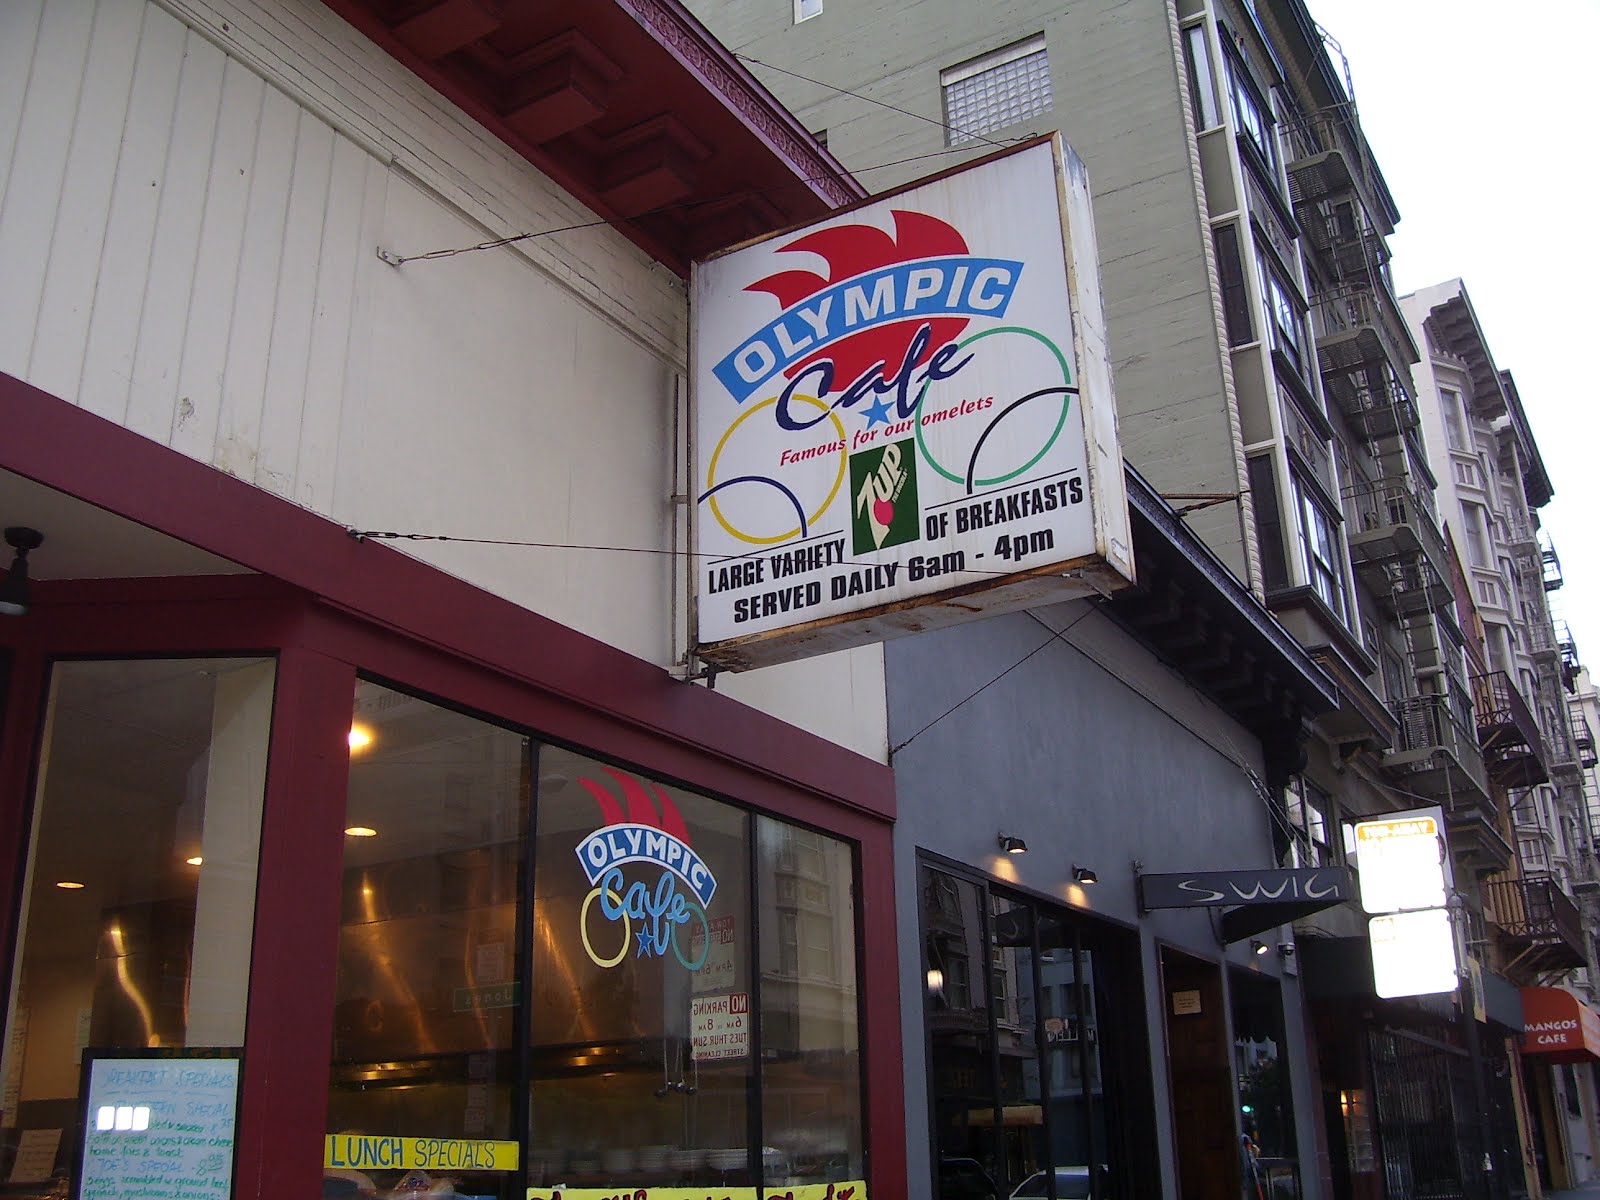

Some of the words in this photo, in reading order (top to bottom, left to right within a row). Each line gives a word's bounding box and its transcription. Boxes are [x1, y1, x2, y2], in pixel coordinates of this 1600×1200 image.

[732, 266, 1012, 384] OLYMPIC
[775, 322, 975, 431] Cafe
[779, 439, 846, 466] Famous
[852, 428, 878, 450] for
[884, 419, 915, 439] our
[920, 395, 994, 428] omelets
[708, 560, 765, 595] LARGE
[770, 539, 847, 578] VARIETY
[925, 511, 950, 541] OF
[956, 476, 1082, 534] BREAKFASTS
[856, 443, 902, 551] 7UP
[734, 581, 821, 624] SERVED
[831, 562, 899, 602] DAILY
[909, 550, 965, 582] 6am
[994, 528, 1055, 562] 4pm
[587, 828, 708, 890] OLYMPIC
[600, 867, 691, 956] Cafe
[1524, 1020, 1577, 1032] MANGOS
[1537, 1034, 1567, 1044] CAFE
[331, 1136, 403, 1168] LUNCH
[414, 1139, 495, 1169] SPECIALS
